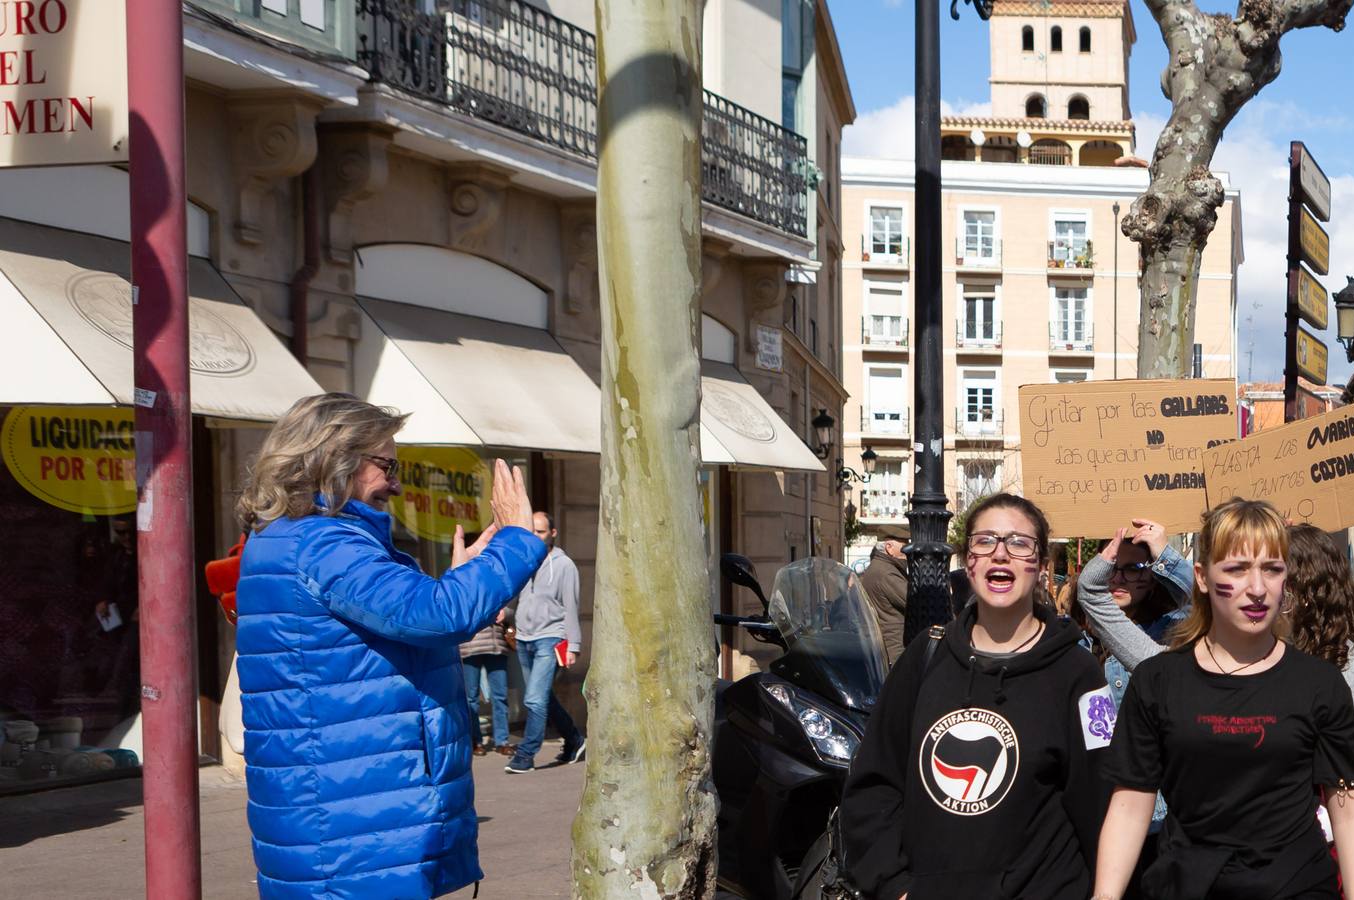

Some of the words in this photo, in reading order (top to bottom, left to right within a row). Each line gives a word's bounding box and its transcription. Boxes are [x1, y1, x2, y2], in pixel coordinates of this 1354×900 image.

[3, 96, 96, 136] MEN
[1028, 395, 1087, 447] Gritar
[1096, 404, 1121, 439] por
[1131, 392, 1156, 418] las
[40, 455, 86, 481] POR
[1087, 450, 1113, 472] que
[1146, 429, 1165, 448] NO
[1210, 445, 1262, 479] HASTA
[1274, 438, 1299, 462] LOS
[1069, 478, 1094, 505] que
[1122, 477, 1141, 493] no
[1250, 471, 1306, 499] TANTOS
[930, 711, 1015, 749] ANTIFASCHISTISCHE
[942, 797, 989, 813] AKTION
